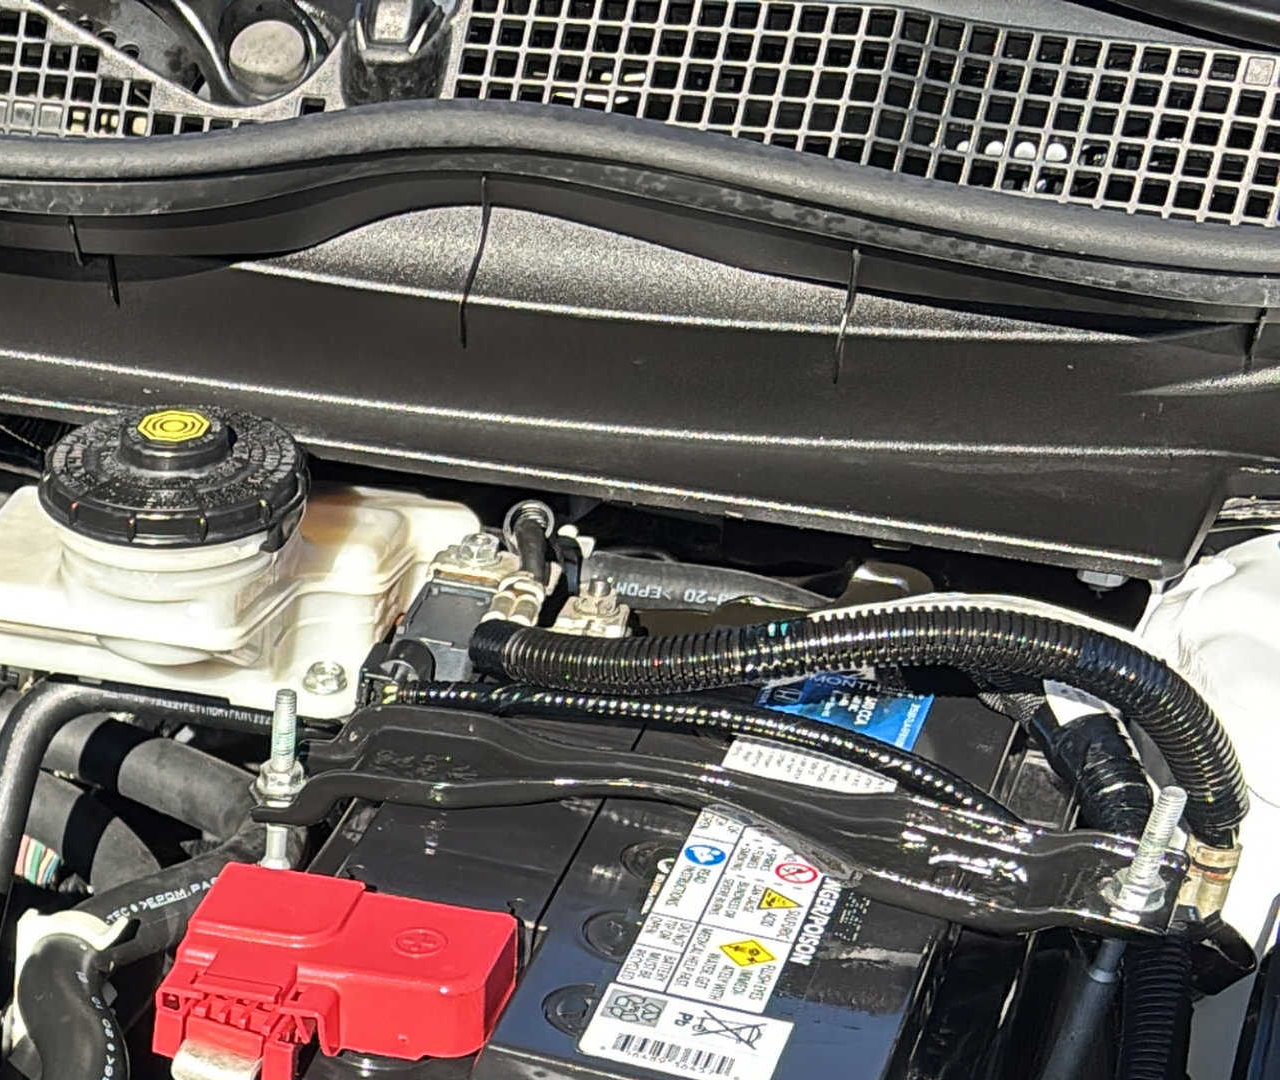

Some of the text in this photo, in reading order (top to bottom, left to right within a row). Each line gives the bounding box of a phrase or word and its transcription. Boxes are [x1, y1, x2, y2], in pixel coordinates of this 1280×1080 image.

[692, 867, 711, 885] READ
[749, 883, 764, 896] CAN
[643, 915, 663, 935] OPEN
[657, 918, 678, 940] TIP OR
[759, 910, 778, 927] ACID
[788, 876, 843, 966] NGER/POISON
[670, 922, 693, 947] DO NOT
[689, 926, 714, 956] MEDICAL
[620, 947, 647, 981] RECYCLED
[637, 951, 662, 979] MUST BE
[653, 954, 677, 982] BATTERY
[680, 954, 700, 972] HELP
[692, 975, 710, 989] GET
[707, 964, 735, 1001] ATELY WITH
[747, 963, 777, 1001] FLUSH EYES
[673, 1010, 690, 1028] Pb
